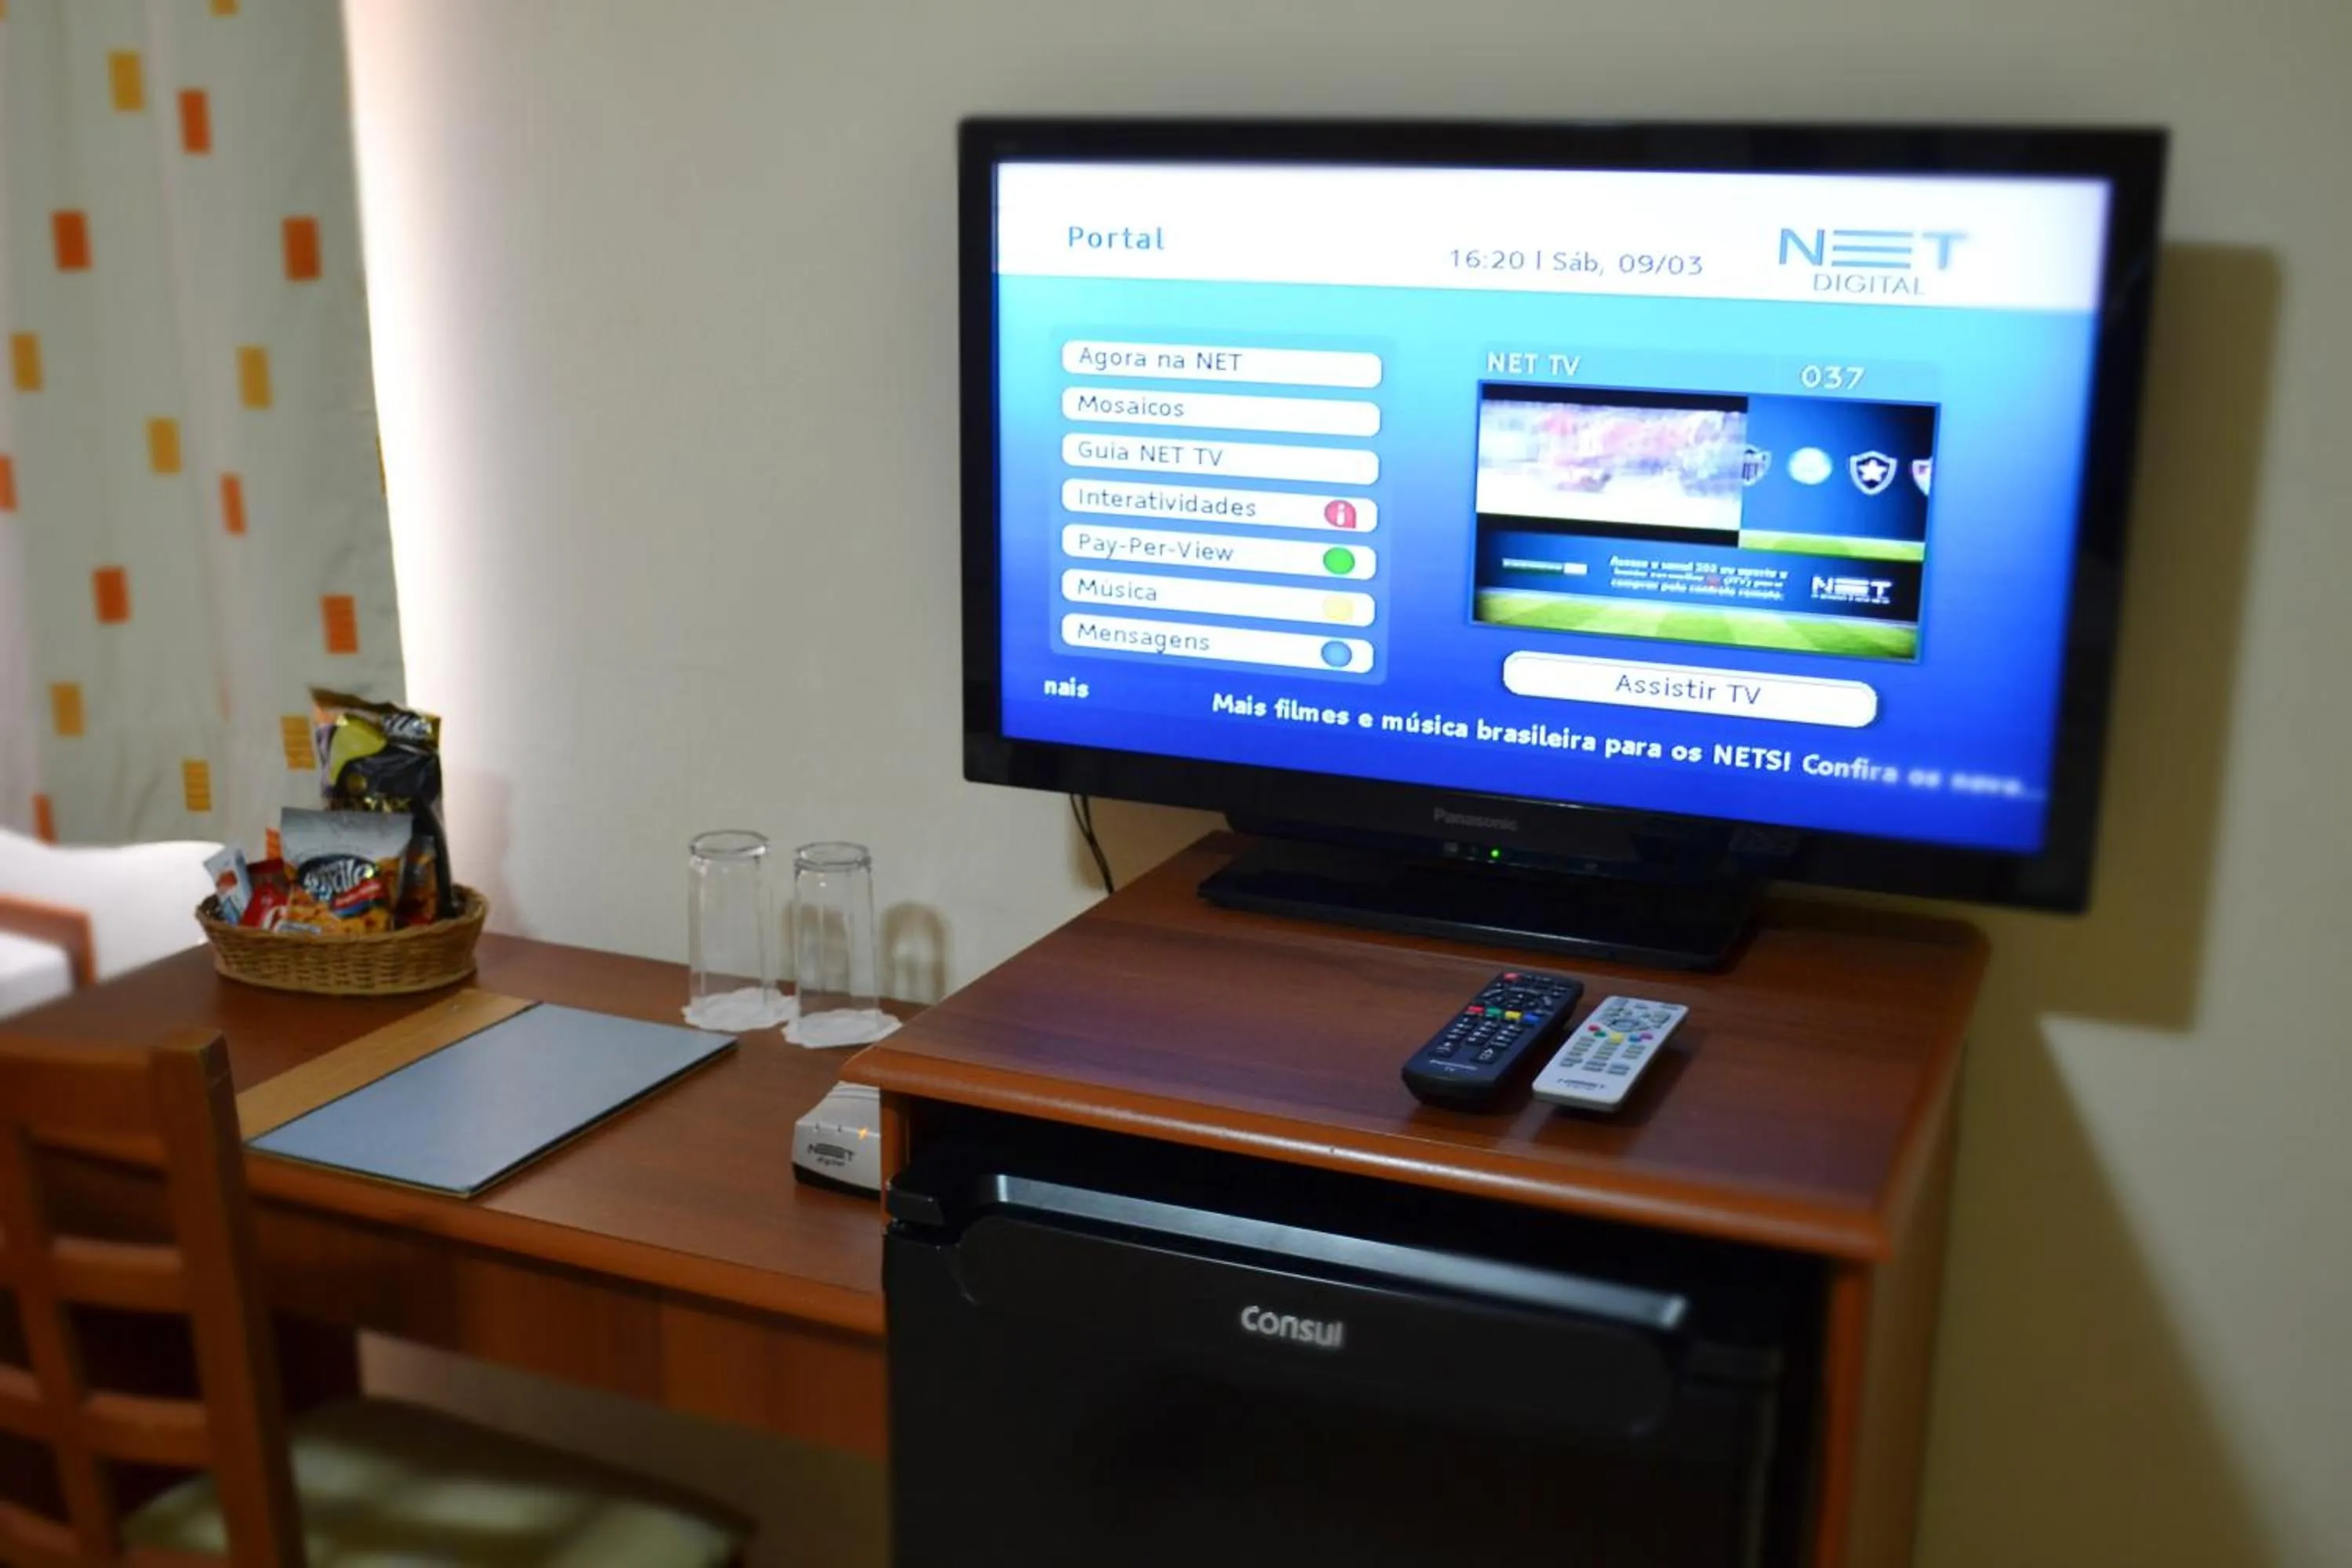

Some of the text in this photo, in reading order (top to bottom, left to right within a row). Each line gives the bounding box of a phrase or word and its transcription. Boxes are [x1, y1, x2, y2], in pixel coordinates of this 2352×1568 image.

[1068, 226, 1165, 251] Portal
[1778, 227, 1968, 271] NET
[1450, 249, 1525, 270] 16:20
[1552, 249, 1605, 277] Sáb,
[1618, 252, 1704, 276] 09/03
[1813, 273, 1926, 296] DIGITAL
[1079, 347, 1243, 372] Agora na NET
[1487, 352, 1581, 377] NET TV
[1800, 365, 1865, 390] 037
[1078, 394, 1185, 417] Mosaicos
[1078, 440, 1224, 466] Guia NET TV
[1079, 488, 1257, 517] Interatividades
[1079, 533, 1234, 561] Pay-Per-View
[1077, 622, 1210, 654] Mensagens
[1615, 674, 1762, 706] Assistir TV
[1044, 677, 1090, 699] nais
[1212, 692, 1268, 717] Mais
[1273, 697, 1349, 726] filmes
[1357, 712, 1373, 728] e
[1381, 712, 1468, 739] música
[1476, 718, 1596, 752] brasileira
[1605, 736, 1663, 759] para
[1671, 743, 1703, 763] os
[1802, 753, 1898, 784] Confira
[1240, 1305, 1344, 1348] Consul
